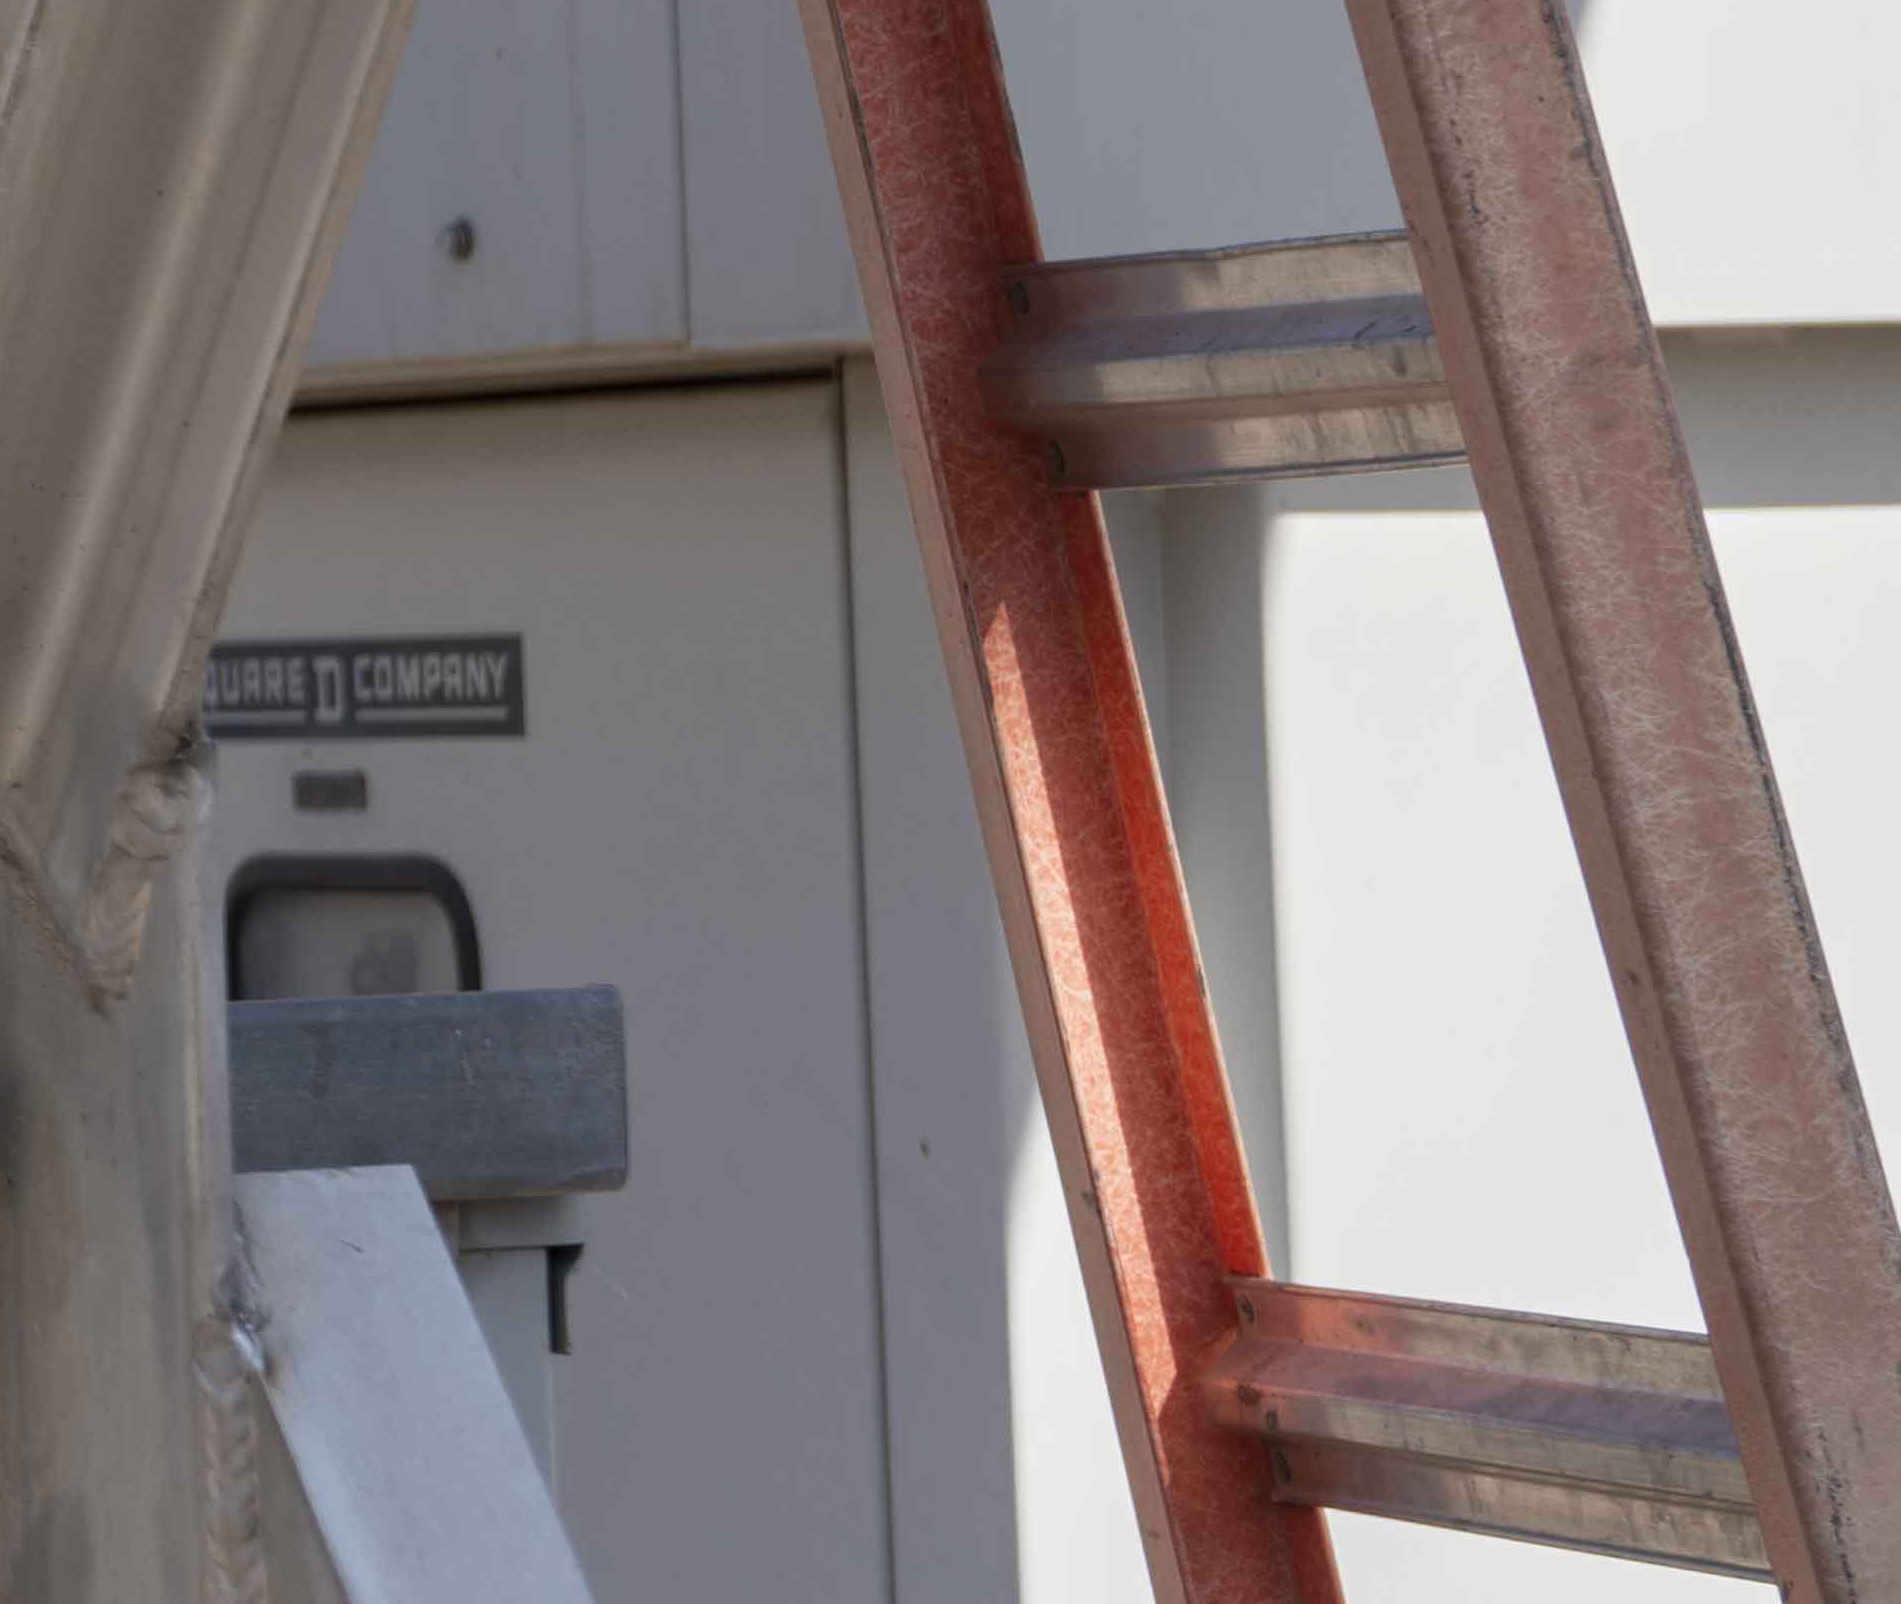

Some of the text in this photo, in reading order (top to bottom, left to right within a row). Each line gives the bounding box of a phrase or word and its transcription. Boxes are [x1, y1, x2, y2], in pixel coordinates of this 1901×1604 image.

[204, 652, 507, 722] QUARE D COMPANY
